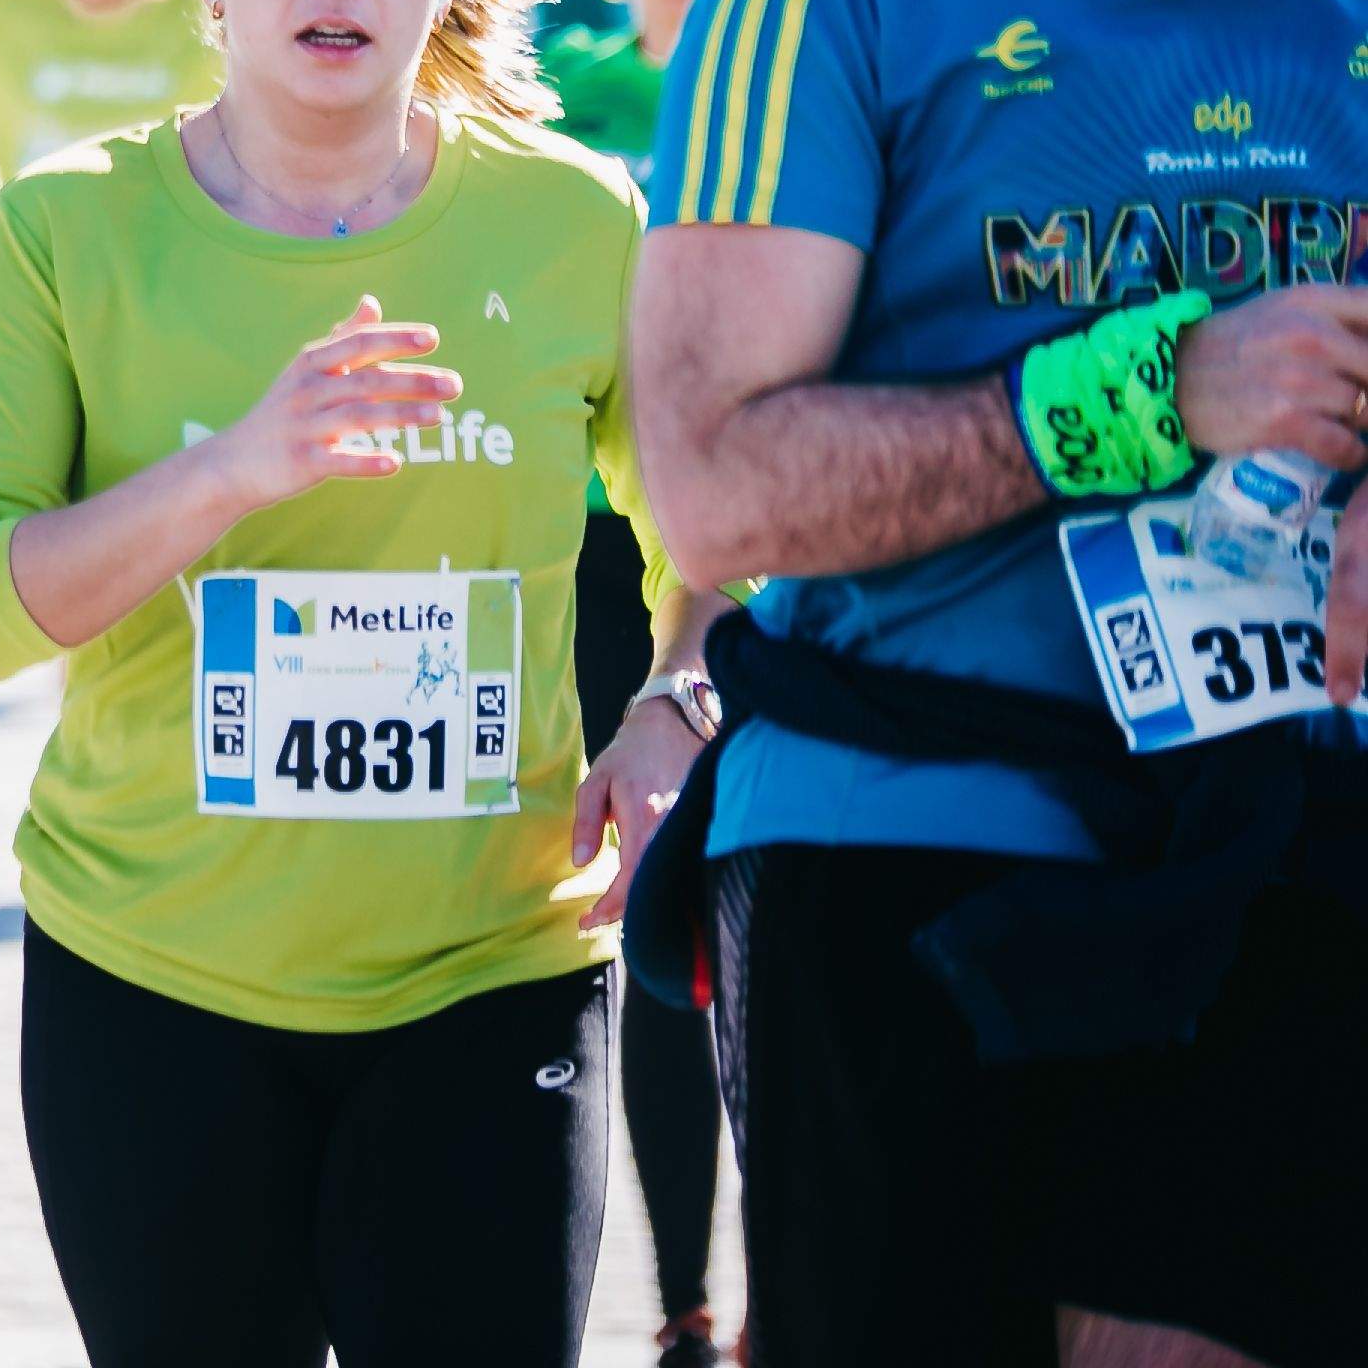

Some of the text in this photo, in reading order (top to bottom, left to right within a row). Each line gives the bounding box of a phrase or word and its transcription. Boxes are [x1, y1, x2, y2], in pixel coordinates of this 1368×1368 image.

[329, 602, 455, 633] MetLife
[1191, 619, 1368, 703] 373
[274, 718, 447, 794] 4831
